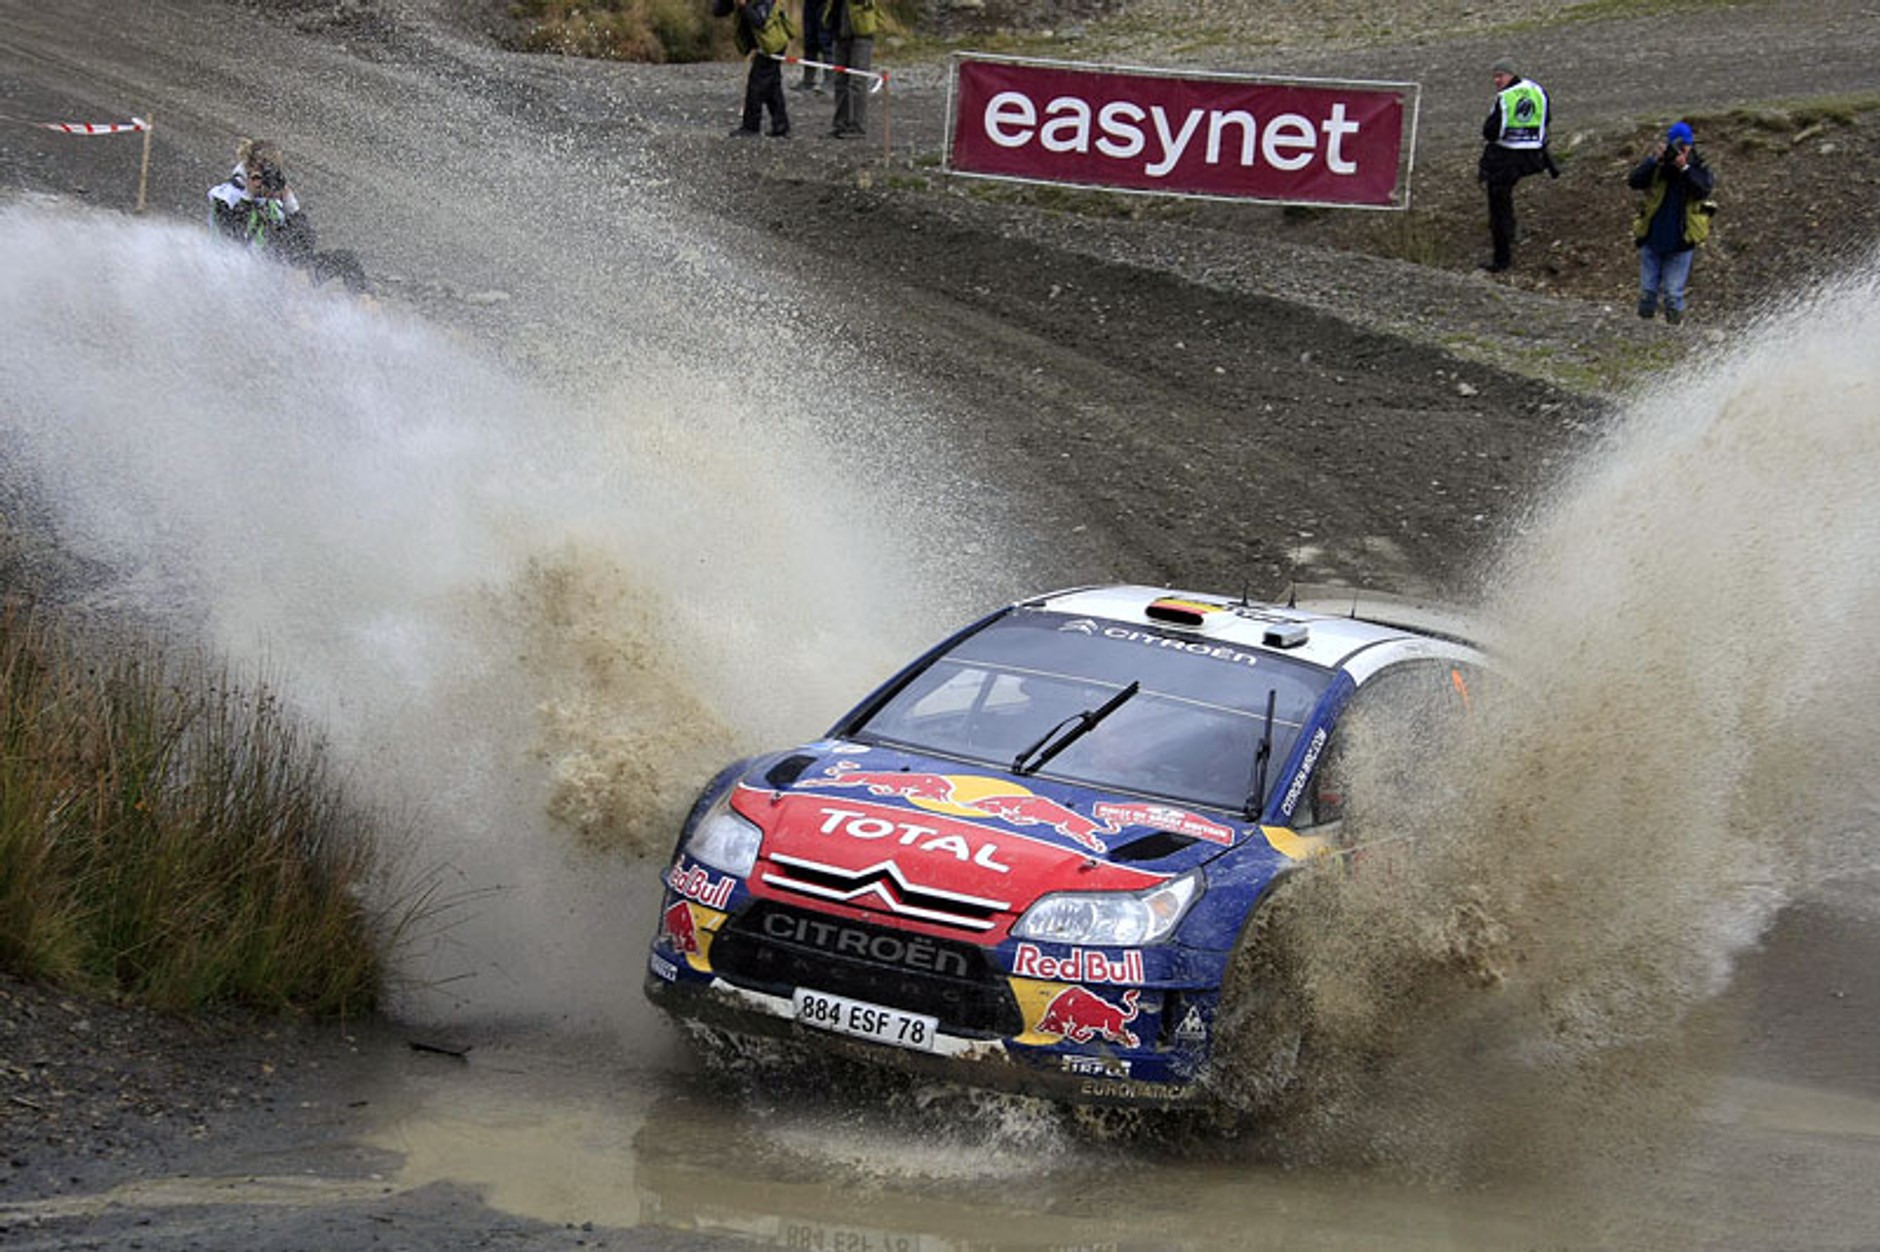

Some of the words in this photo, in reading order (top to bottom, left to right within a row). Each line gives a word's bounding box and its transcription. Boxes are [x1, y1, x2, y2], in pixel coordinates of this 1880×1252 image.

[983, 91, 1360, 177] easynet
[820, 808, 1011, 873] TOTAL
[802, 995, 841, 1025] 884
[849, 1006, 890, 1035] ESF
[898, 1016, 926, 1044] 78
